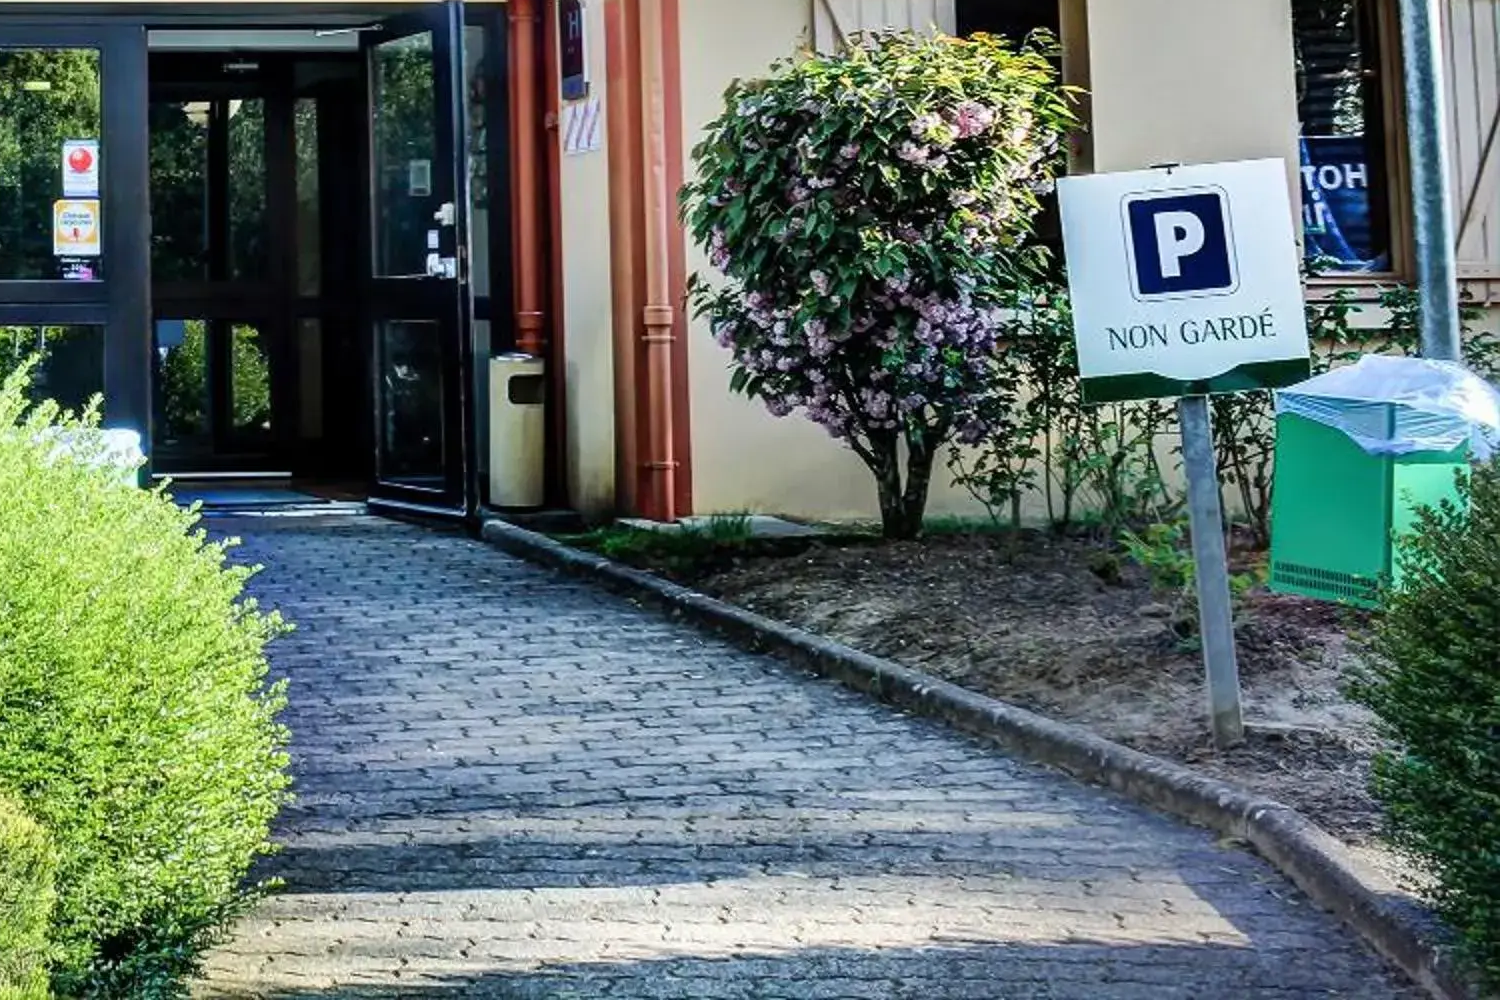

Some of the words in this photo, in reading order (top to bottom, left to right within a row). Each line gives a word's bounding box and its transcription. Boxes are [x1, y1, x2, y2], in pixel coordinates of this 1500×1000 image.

[1153, 210, 1206, 279] P
[1106, 324, 1168, 351] NON
[1179, 307, 1277, 346] GARDÉ
